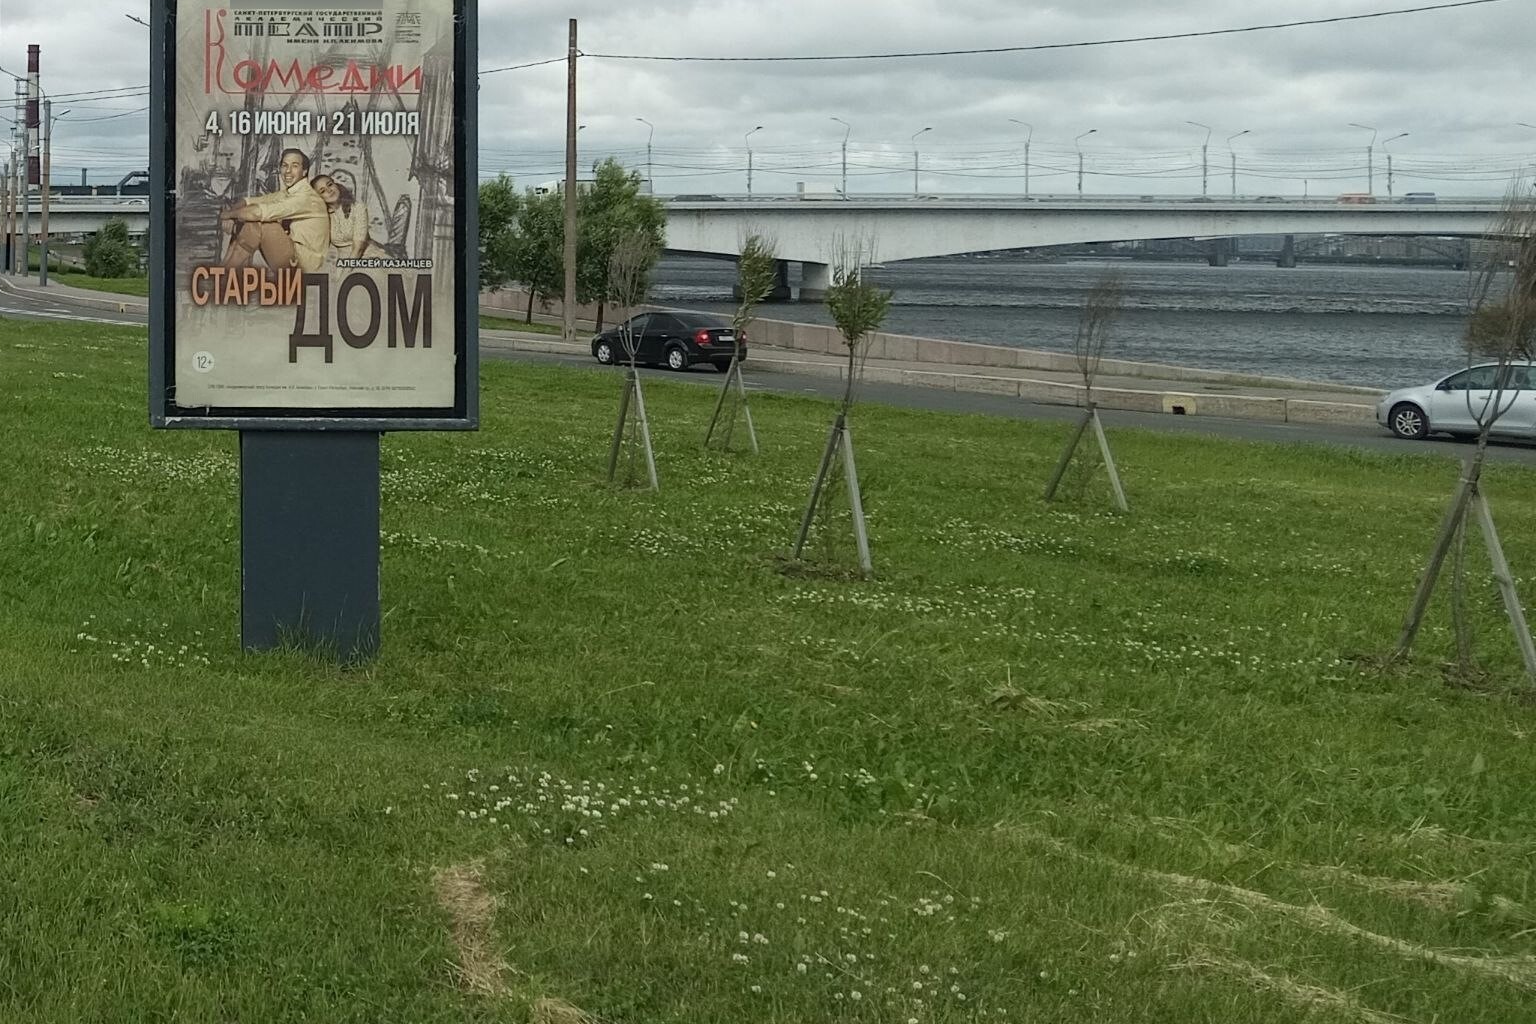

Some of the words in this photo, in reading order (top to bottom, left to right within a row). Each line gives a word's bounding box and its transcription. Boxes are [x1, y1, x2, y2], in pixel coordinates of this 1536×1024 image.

[205, 111, 223, 137] 4,
[229, 110, 251, 135] 16
[254, 111, 311, 135] ИЮНЯ
[332, 111, 356, 135] 21
[361, 111, 420, 135] ИЮЛЯ
[336, 258, 381, 269] АЛЕКСЕЙ
[382, 259, 433, 269] КАЗАНЦЕВ
[191, 259, 302, 306] СТАРЫЙ
[289, 272, 432, 364] ДОМ
[196, 355, 213, 369] 12+
